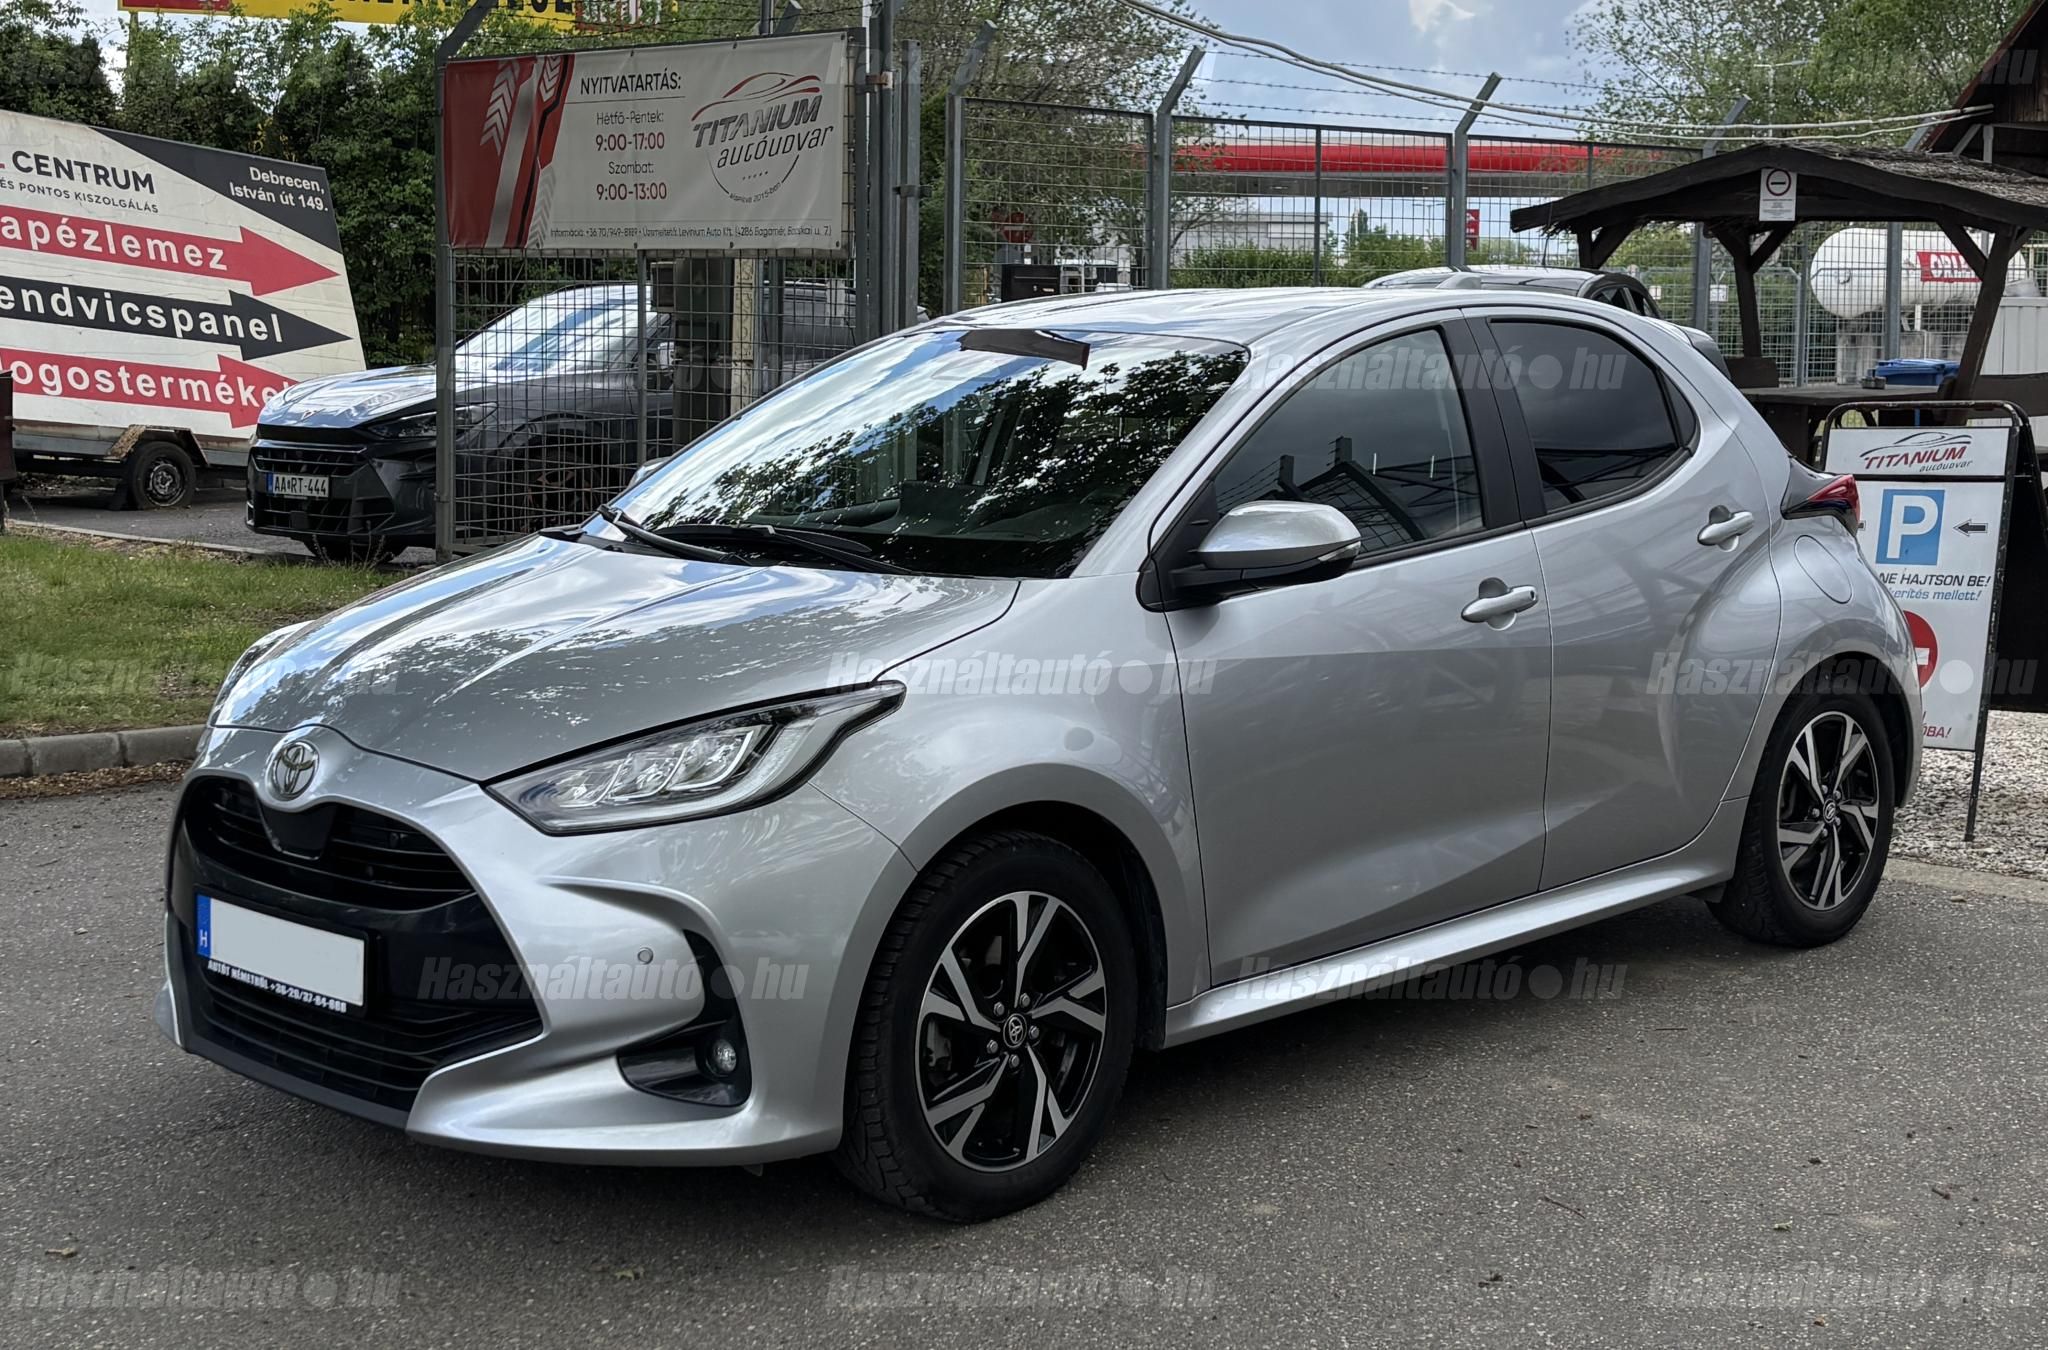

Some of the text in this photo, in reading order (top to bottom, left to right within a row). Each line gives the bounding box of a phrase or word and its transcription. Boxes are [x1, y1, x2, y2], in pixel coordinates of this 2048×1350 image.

[580, 67, 682, 95] NYITVATARTÁS:
[692, 94, 823, 148] TITANIUM
[595, 132, 665, 151] 9:00-17:00
[717, 125, 834, 168] autóudvar
[12, 150, 155, 194] CENTRUM
[249, 166, 325, 195] Debrecen,
[608, 161, 654, 175] Szombat:
[0, 177, 159, 213] ÉS PONTOS KISZOLGÁLÁS
[229, 181, 329, 212] István út 149.
[596, 182, 667, 200] 9:00-13:00
[1, 215, 228, 271] apézlemez
[0, 285, 283, 343] endvicspanel
[10, 360, 289, 408] ogosterméke
[1864, 445, 1968, 470] TITANIUM
[1886, 495, 1939, 559] P
[1889, 585, 1982, 600] erítés mellett!
[1900, 572, 1964, 586] HAJTSON
[1967, 575, 1992, 587] BE!
[199, 929, 208, 948] H
